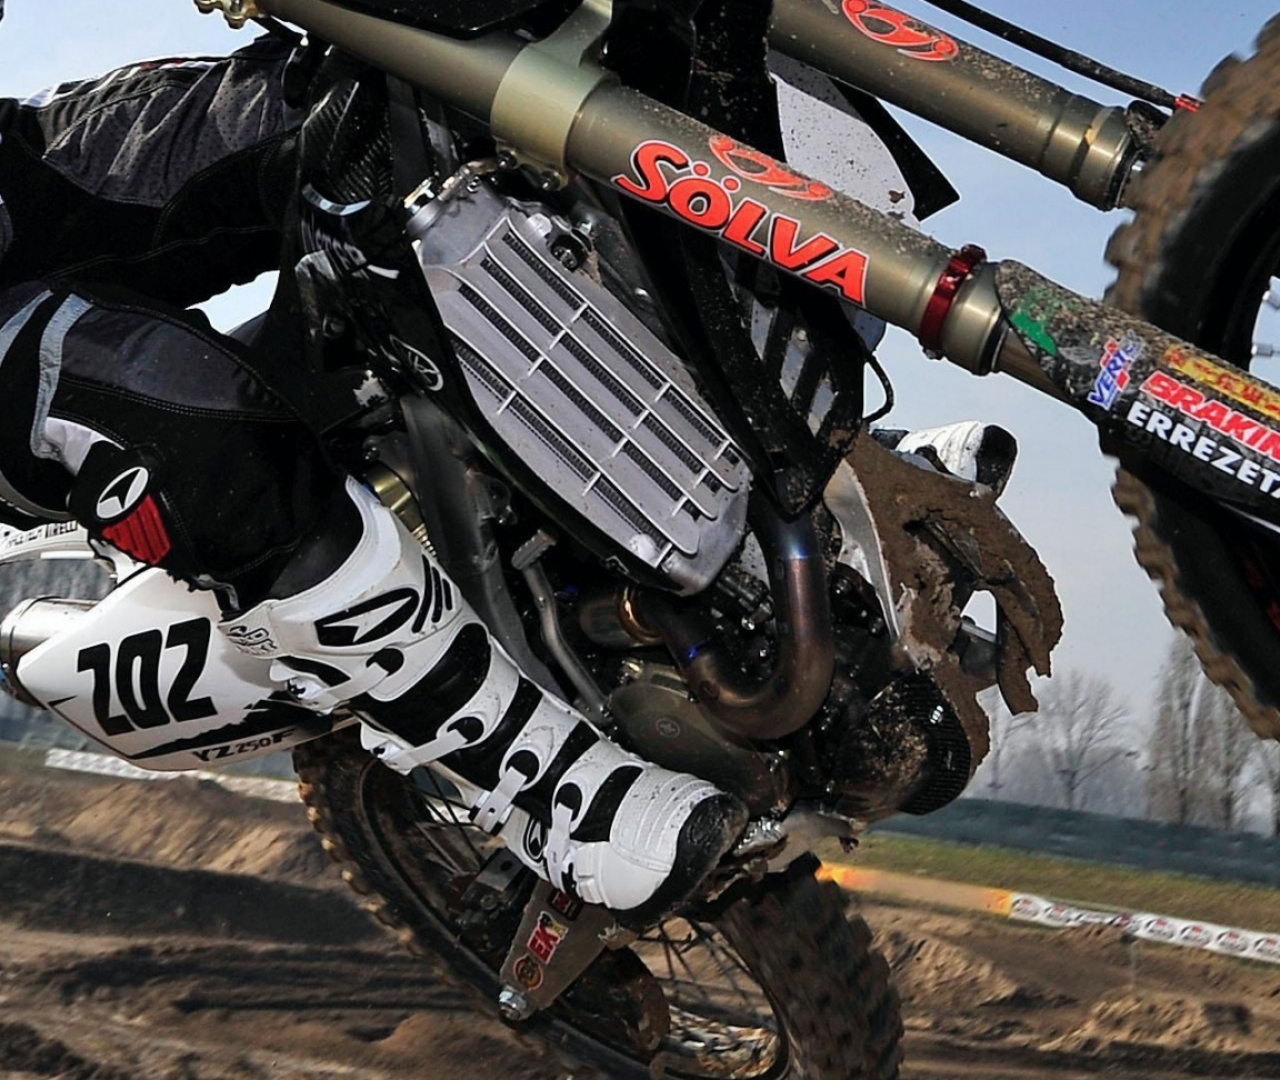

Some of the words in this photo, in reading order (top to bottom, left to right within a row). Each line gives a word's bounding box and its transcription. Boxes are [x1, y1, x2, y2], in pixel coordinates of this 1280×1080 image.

[617, 139, 870, 308] SÖLVA
[77, 617, 218, 737] 202
[192, 728, 297, 762] YZ250F
